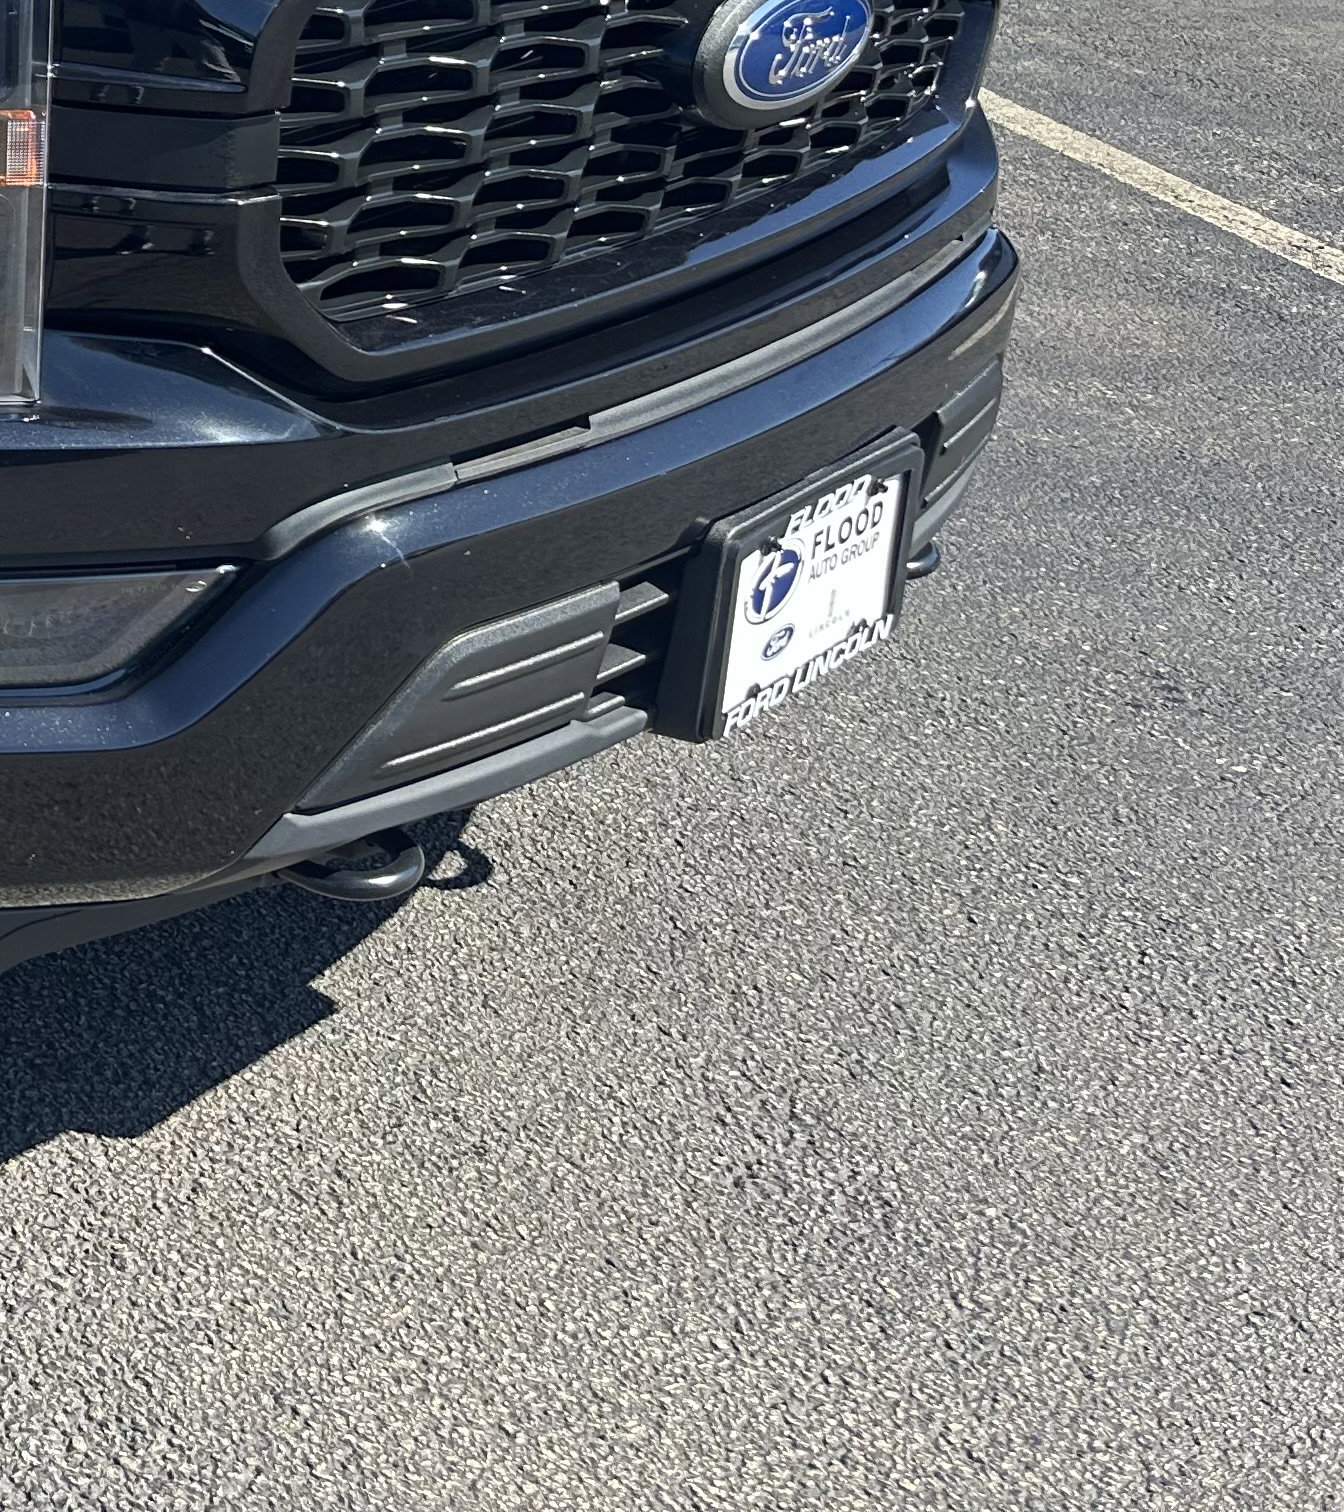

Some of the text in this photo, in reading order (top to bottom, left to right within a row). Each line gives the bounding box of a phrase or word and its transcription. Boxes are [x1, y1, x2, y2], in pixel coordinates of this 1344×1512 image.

[768, 6, 851, 86] Ford
[783, 474, 872, 540] FLOOD
[811, 501, 884, 560] FLOOD
[808, 531, 880, 585] AUTO GROUP
[723, 613, 894, 738] FORD LINCOLN
